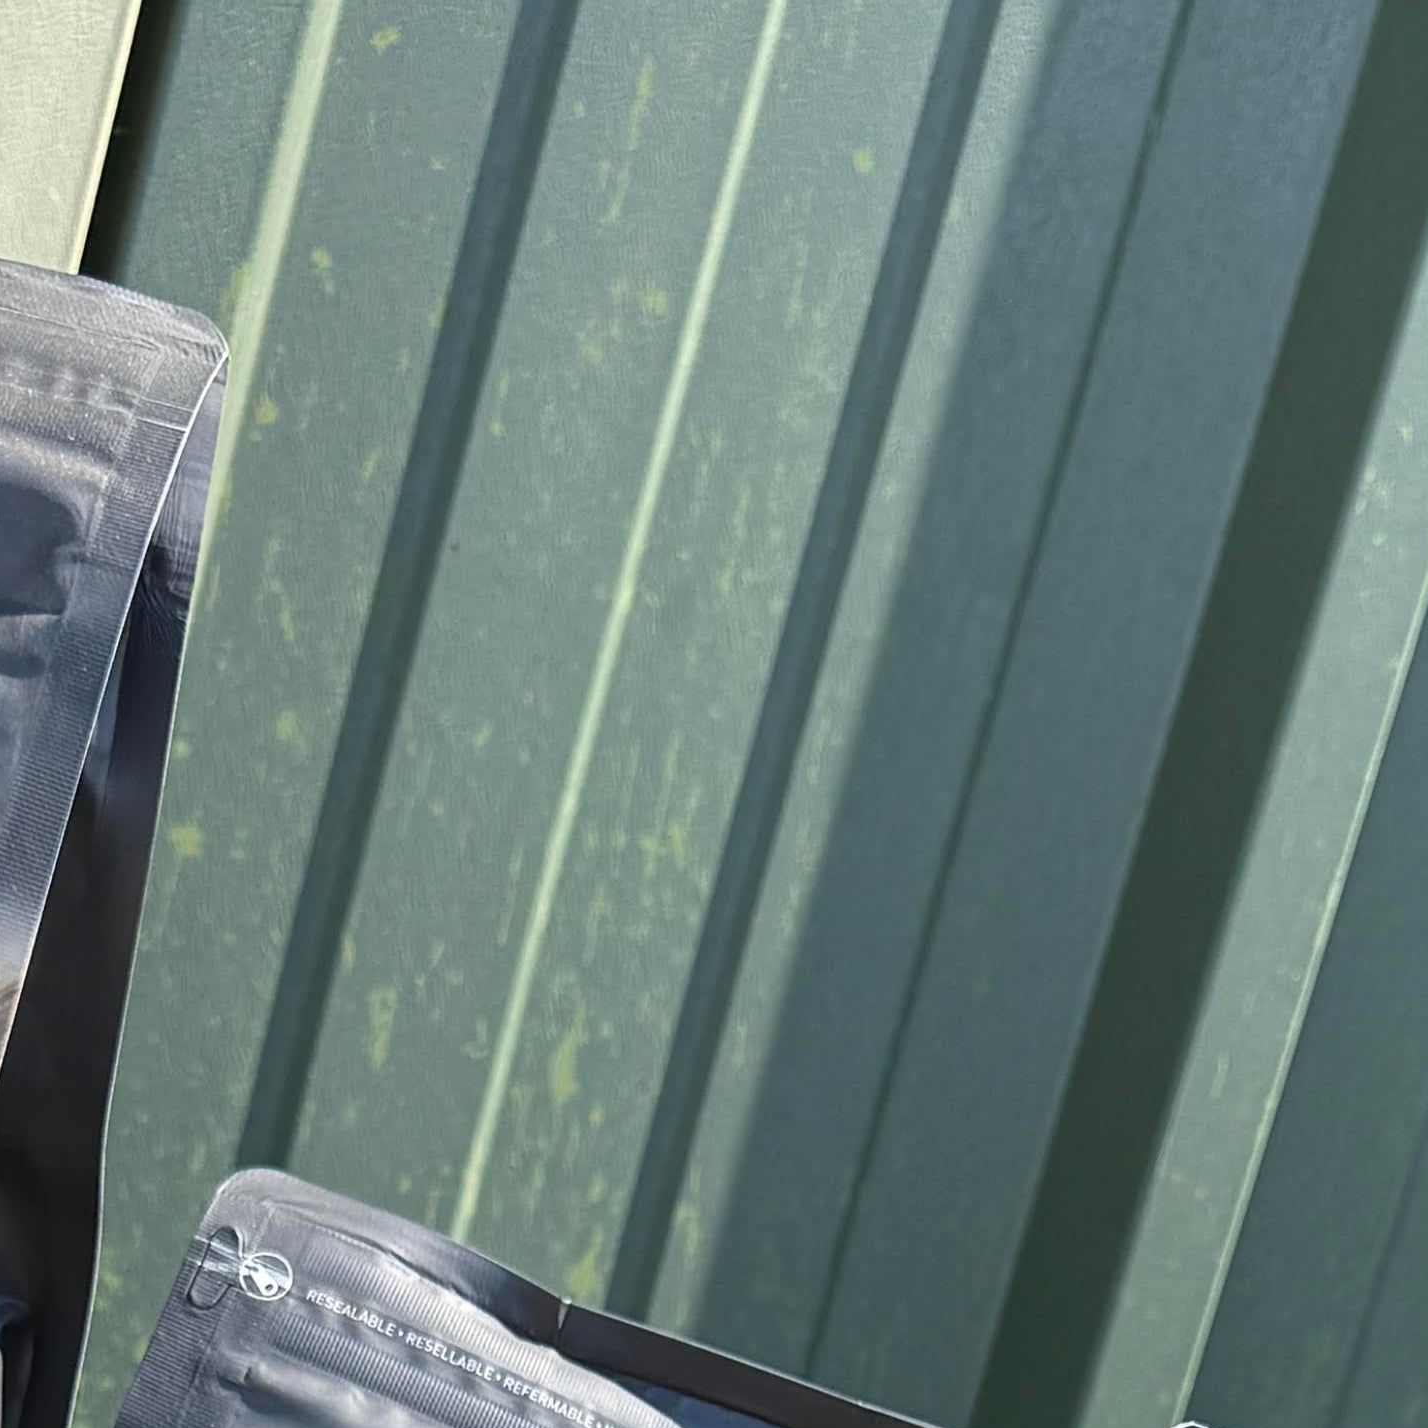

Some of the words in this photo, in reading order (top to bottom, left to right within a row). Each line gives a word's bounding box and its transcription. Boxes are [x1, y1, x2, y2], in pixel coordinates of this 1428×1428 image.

[305, 1288, 397, 1335] RESEALABLE
[405, 1329, 495, 1380] RESELLABLE
[502, 1373, 596, 1428] REFERMABLE
